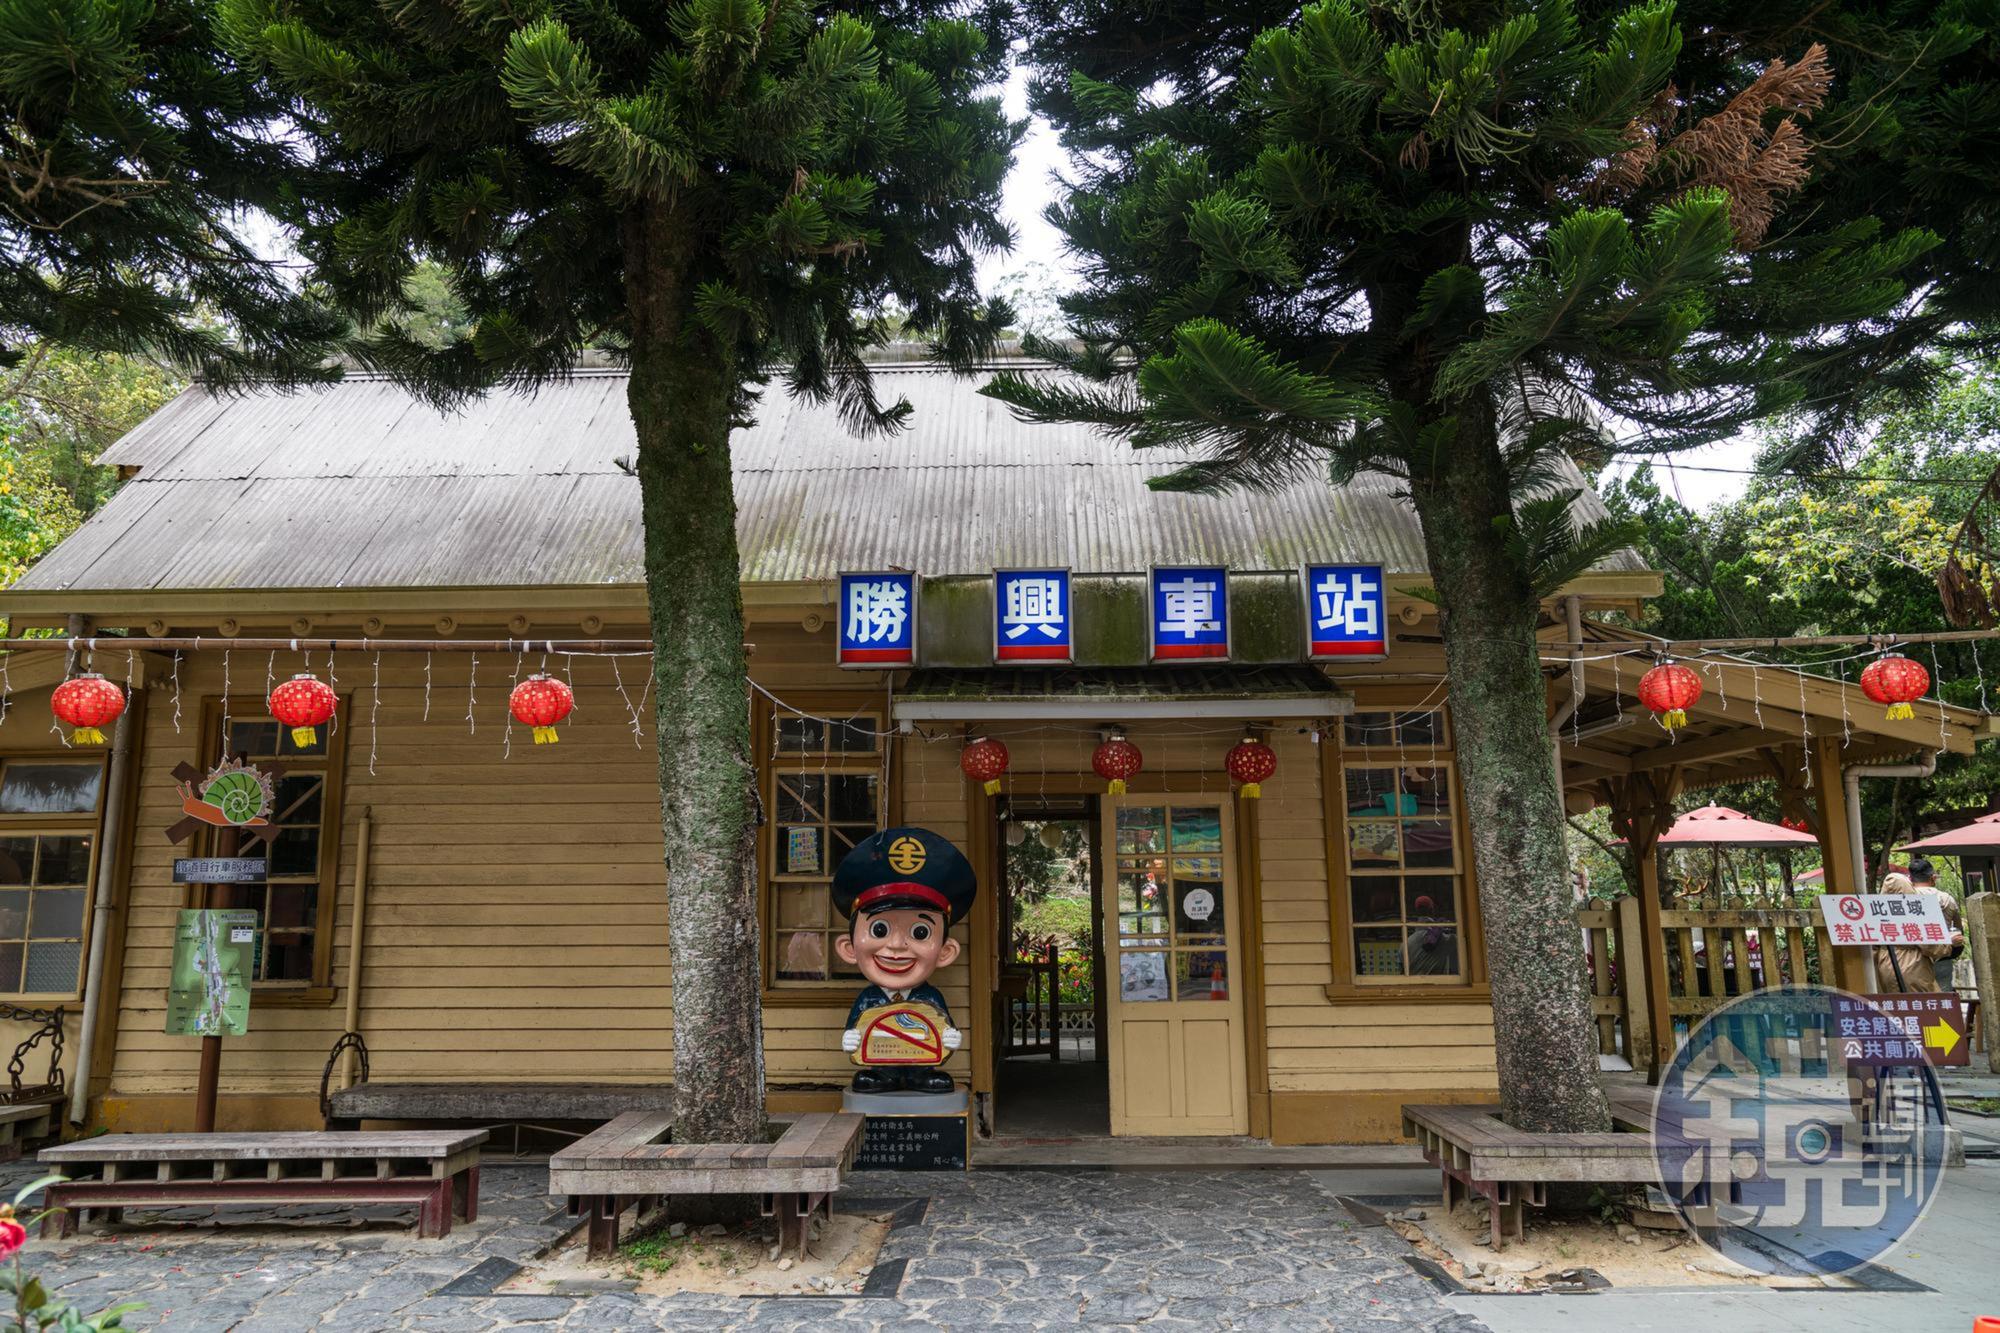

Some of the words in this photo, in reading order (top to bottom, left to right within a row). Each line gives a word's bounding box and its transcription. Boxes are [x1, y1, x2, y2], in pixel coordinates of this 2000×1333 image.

[846, 573, 1378, 643] 勝興車站
[1869, 899, 1926, 917] 此區域
[1834, 923, 1945, 943] 禁止停機車
[1840, 1016, 1921, 1036] 安全解說區
[1844, 1040, 1924, 1059] 公共廁所
